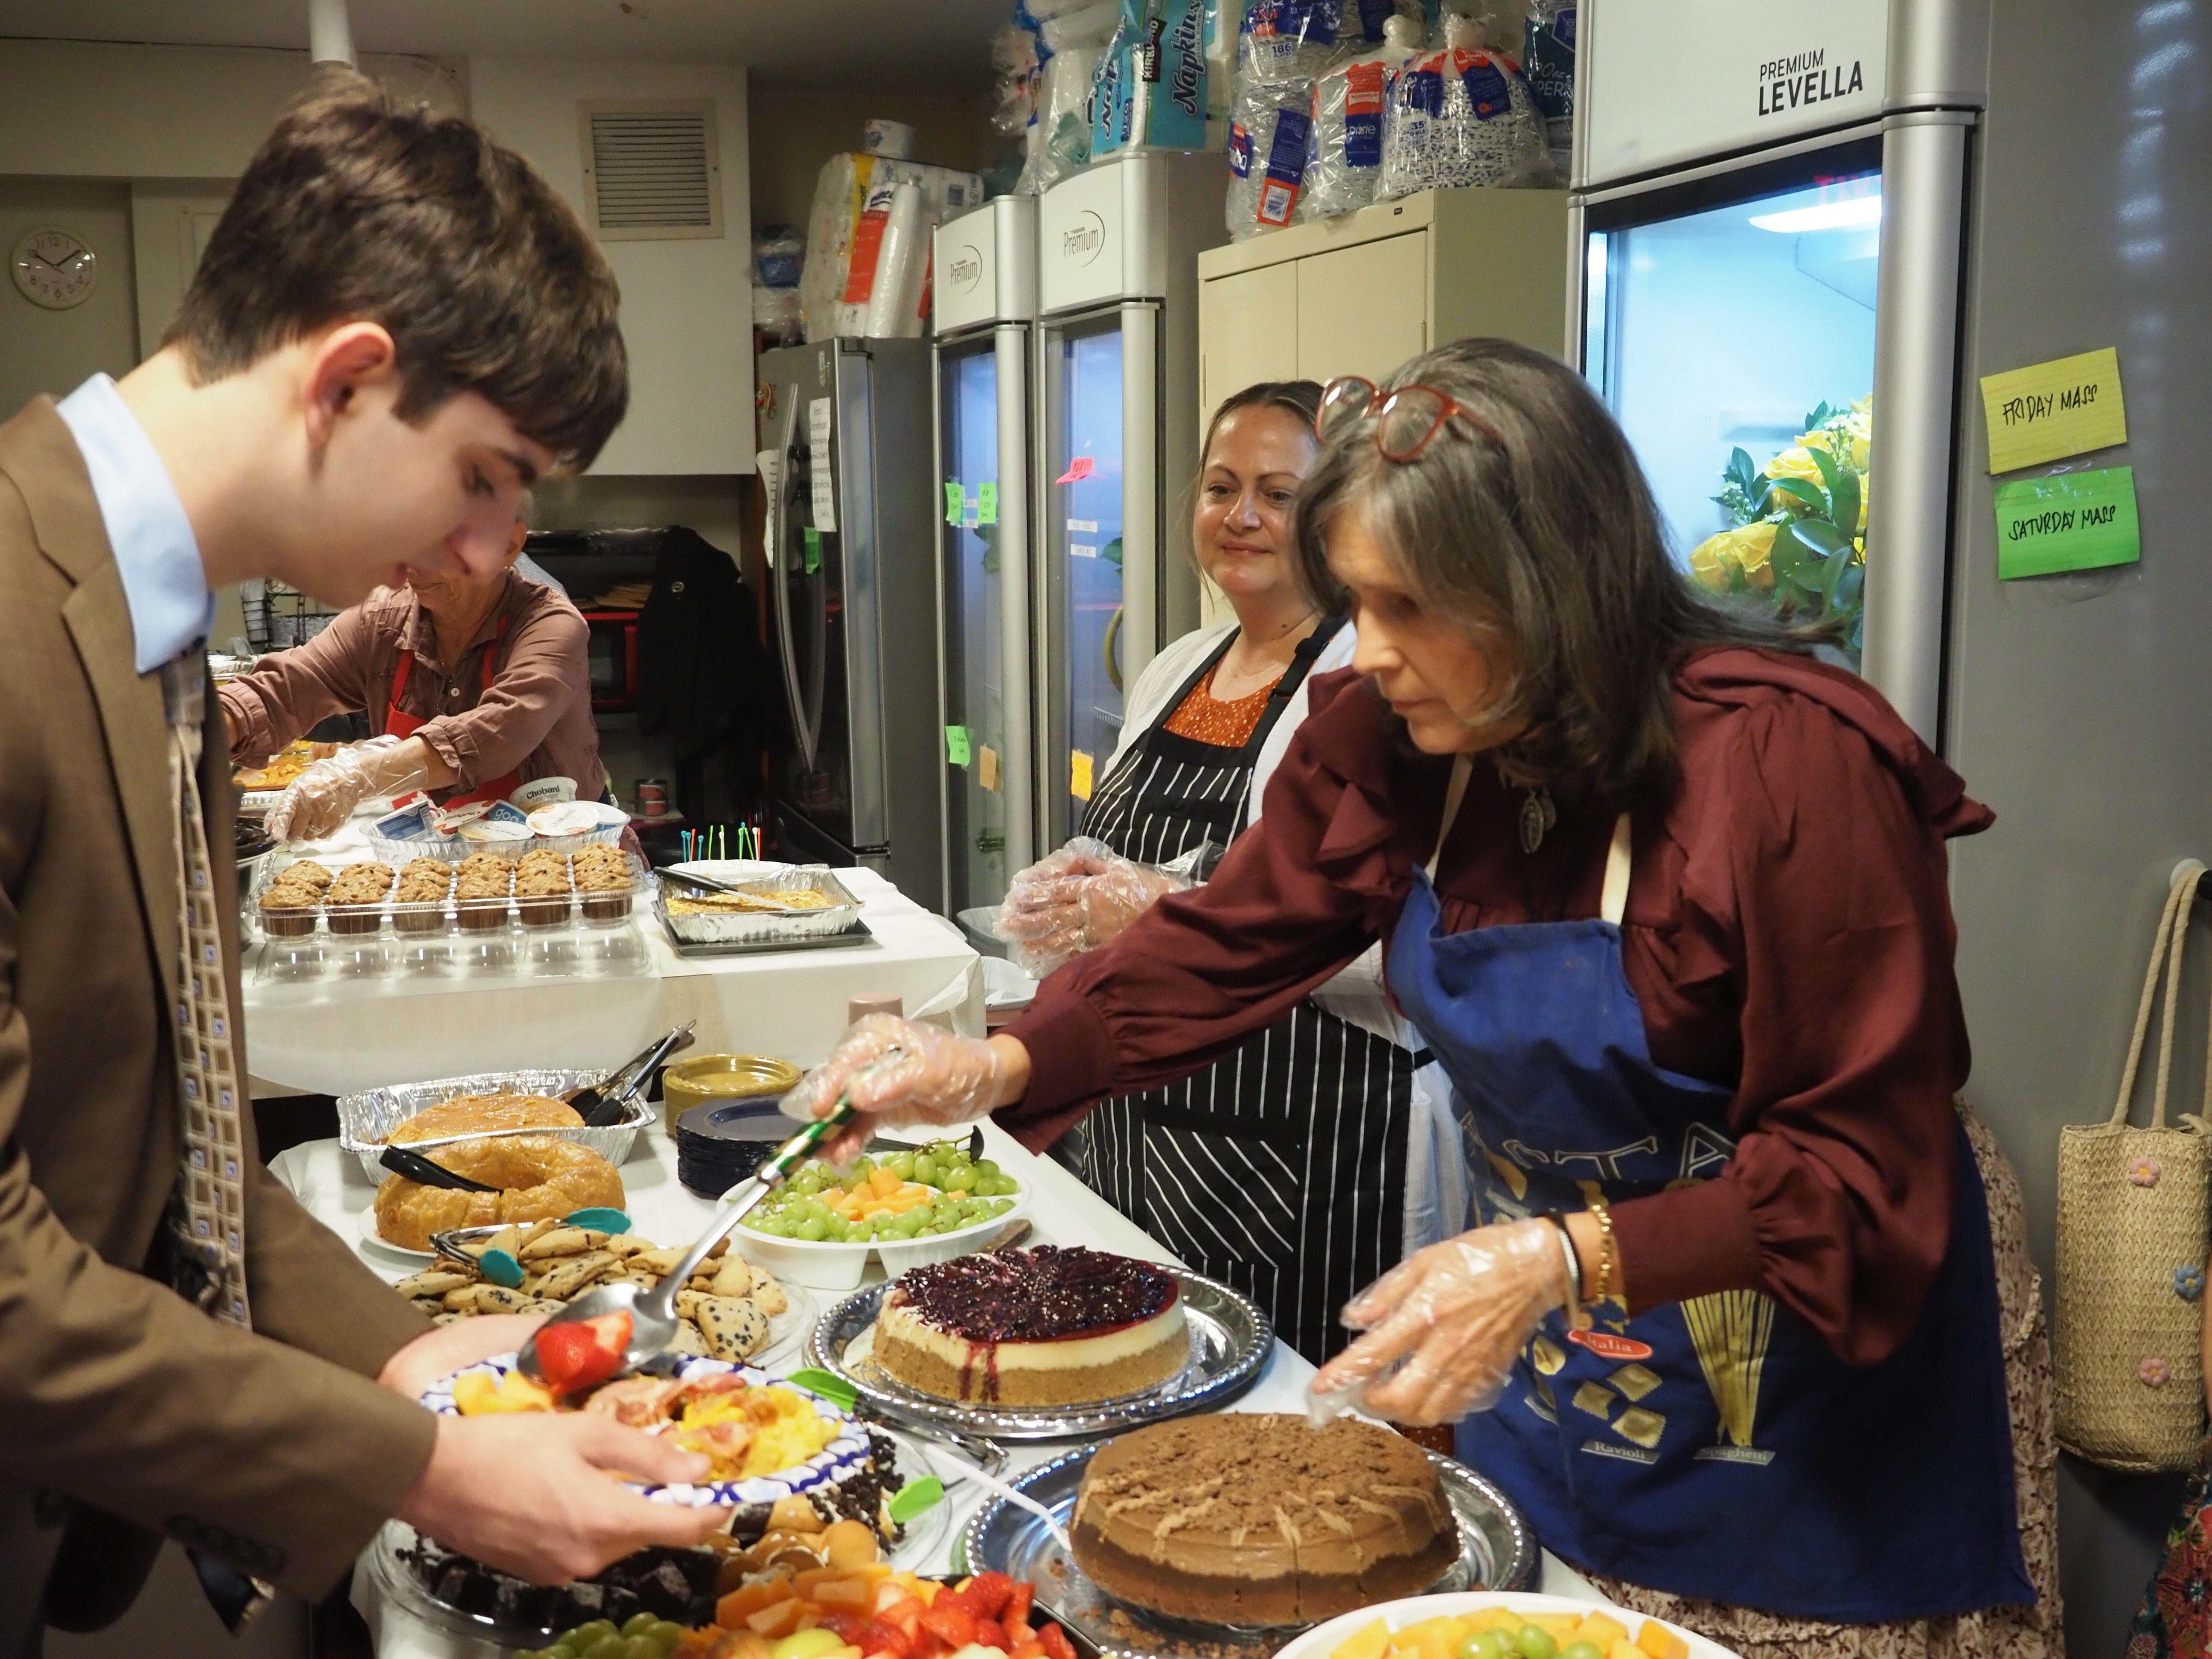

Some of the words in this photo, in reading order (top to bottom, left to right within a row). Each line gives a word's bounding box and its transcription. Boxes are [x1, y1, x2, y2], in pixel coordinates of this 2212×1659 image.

[1144, 20, 1159, 79] KIRKLND
[1171, 0, 1207, 116] Napkins
[1272, 43, 1292, 54] 186
[1760, 47, 1824, 82] PREMIUM
[1758, 60, 1863, 116] LEVELLA
[1063, 228, 1099, 257] Premium
[950, 260, 978, 285] Premium
[2002, 393, 2054, 426] FRIDAY
[2061, 384, 2097, 410] MASS
[2008, 510, 2075, 541] SATURDAY
[2081, 505, 2116, 529] MASS
[526, 785, 560, 799] Chobani
[1586, 1334, 1632, 1352] Italia
[1595, 1441, 1646, 1460] Ravioli
[1699, 1446, 1767, 1462] Spaghetti
